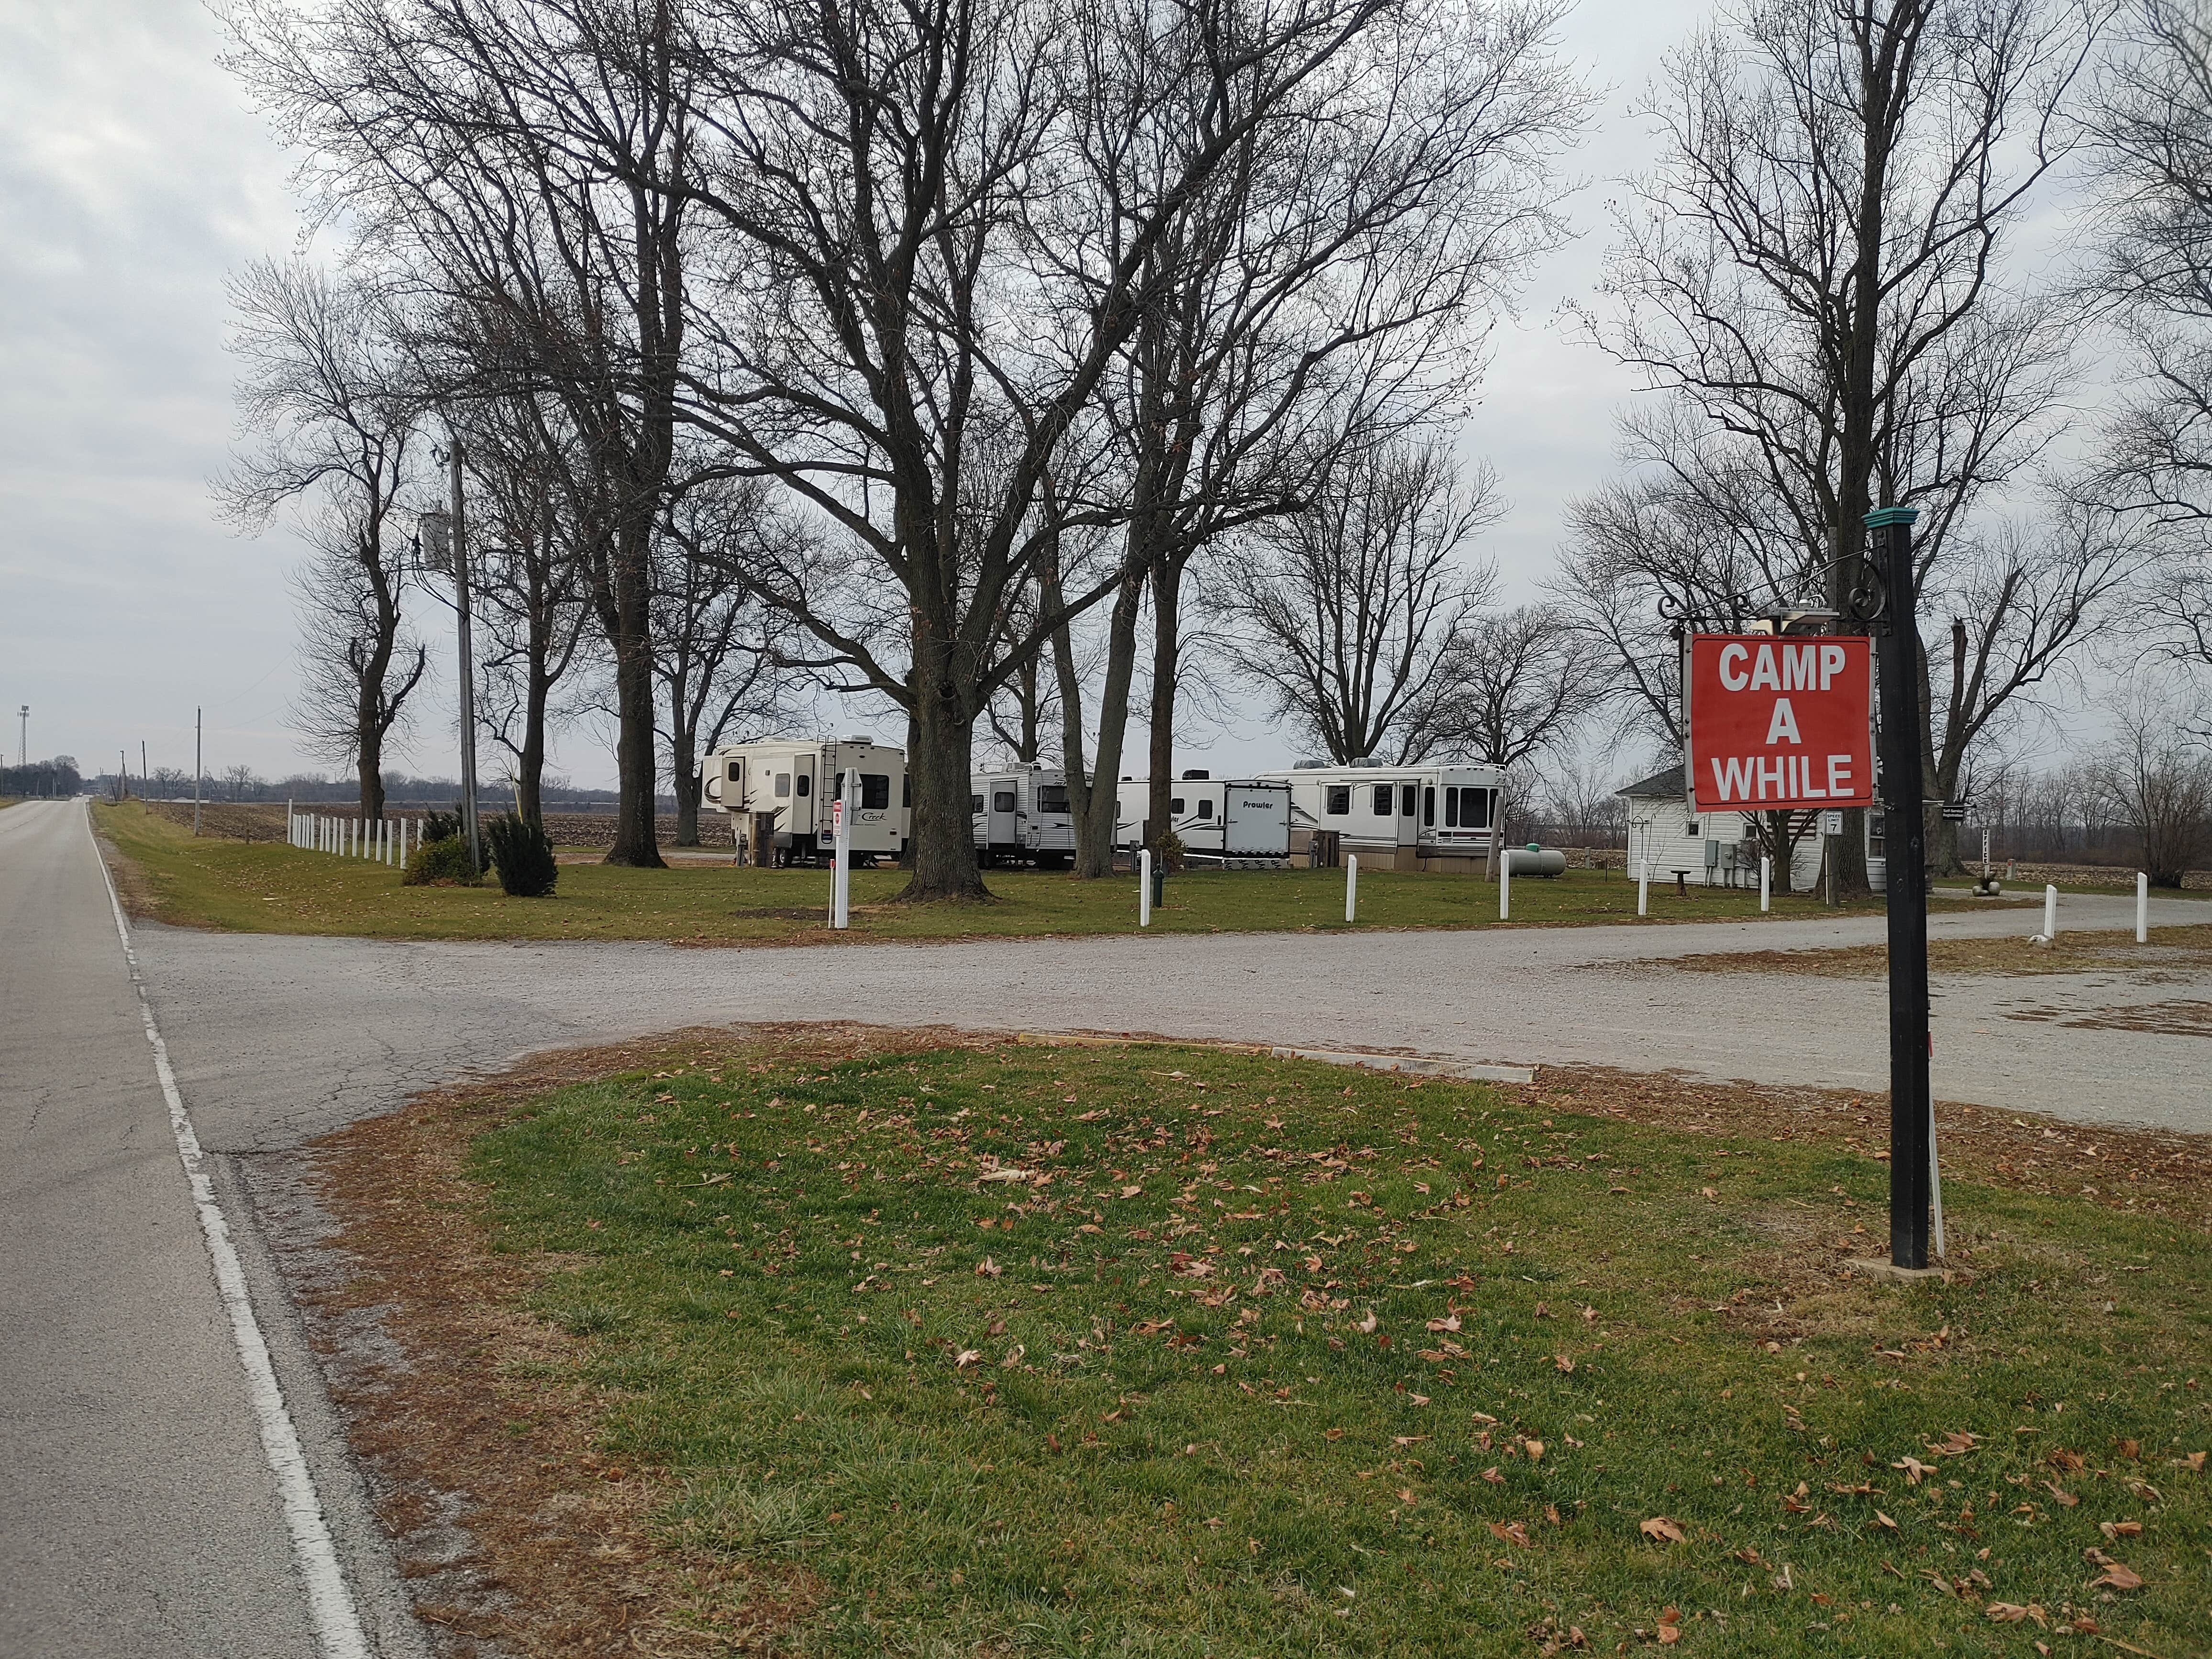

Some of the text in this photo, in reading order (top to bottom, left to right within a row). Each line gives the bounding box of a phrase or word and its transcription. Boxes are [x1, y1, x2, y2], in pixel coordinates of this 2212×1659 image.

[1719, 643, 1846, 691] CAMP
[1765, 698, 1802, 744] A
[1711, 754, 1854, 801] WHILE
[862, 812, 887, 821] Creek
[1243, 801, 1273, 809] Prowler
